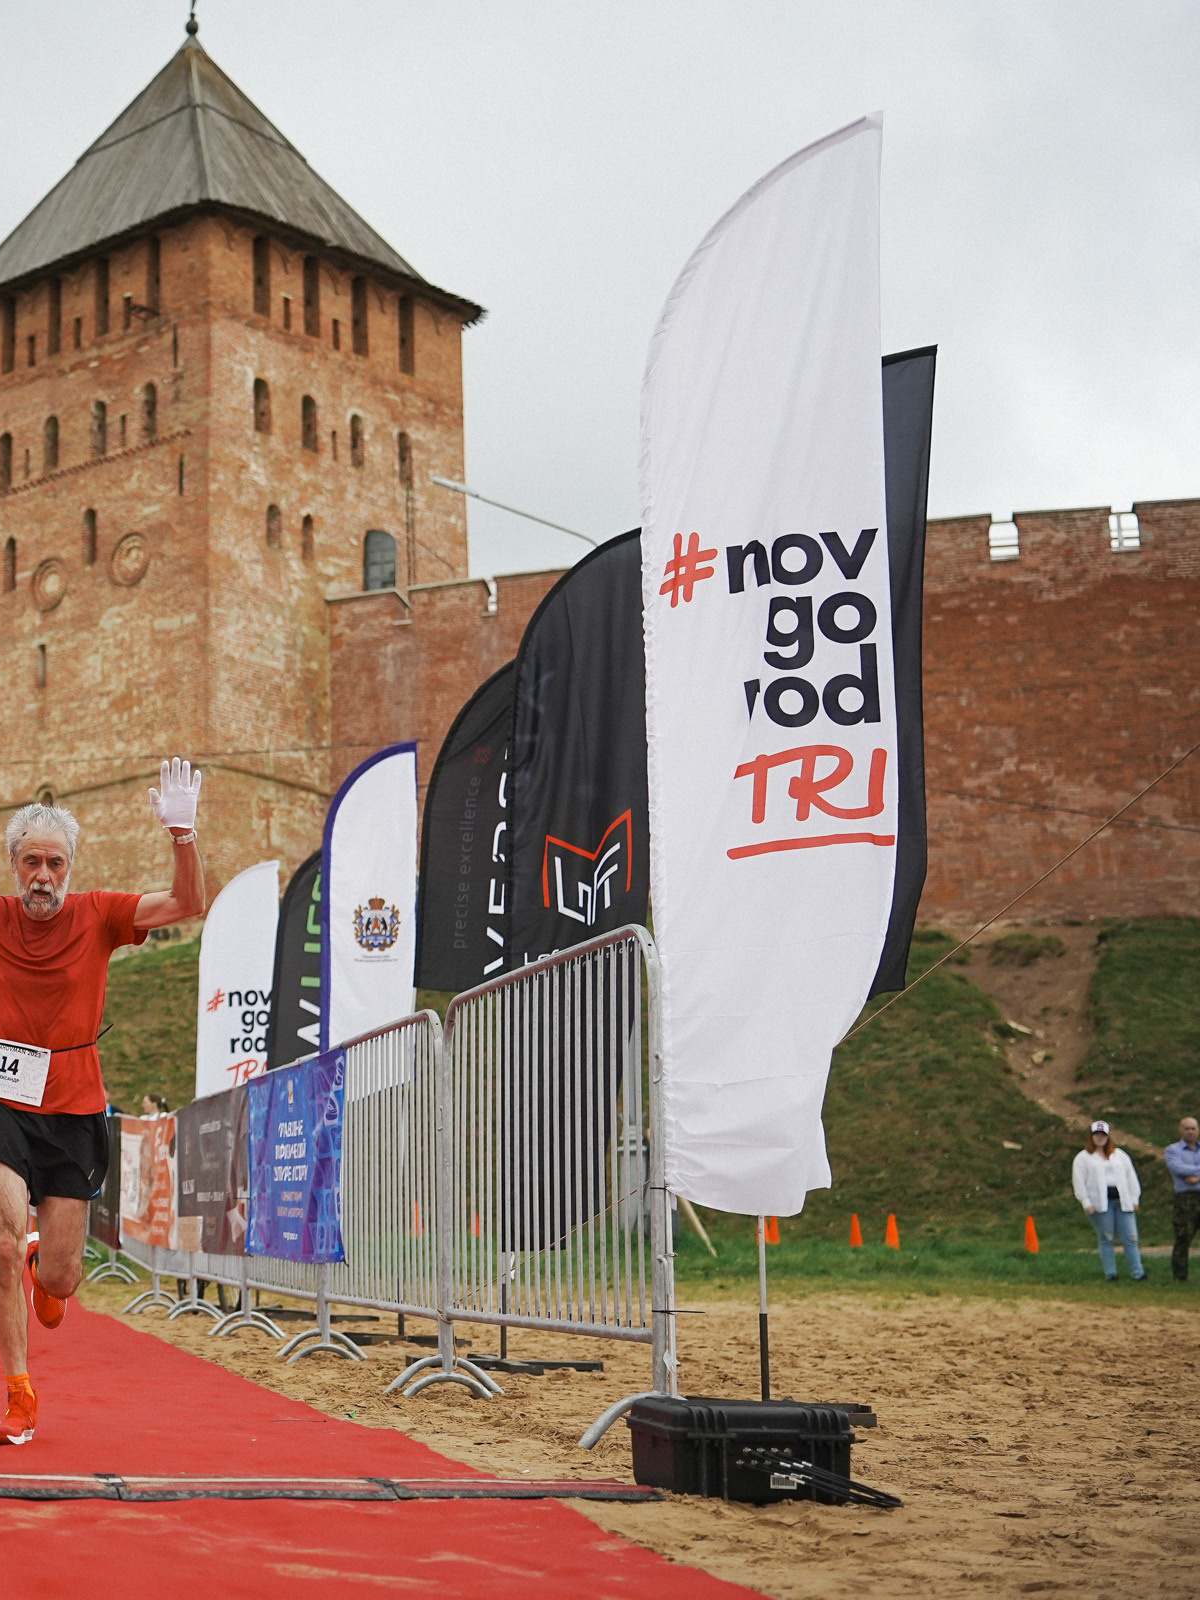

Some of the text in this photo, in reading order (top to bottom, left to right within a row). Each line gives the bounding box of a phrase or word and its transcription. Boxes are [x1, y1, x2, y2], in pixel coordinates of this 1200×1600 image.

[659, 528, 879, 608] #nov
[763, 591, 878, 670] go
[733, 744, 888, 824] TRI
[453, 775, 481, 949] precise excellence
[207, 989, 272, 1011] #nov
[241, 1010, 270, 1033] go
[27, 1050, 42, 1059] 2023
[227, 1059, 267, 1085] TR
